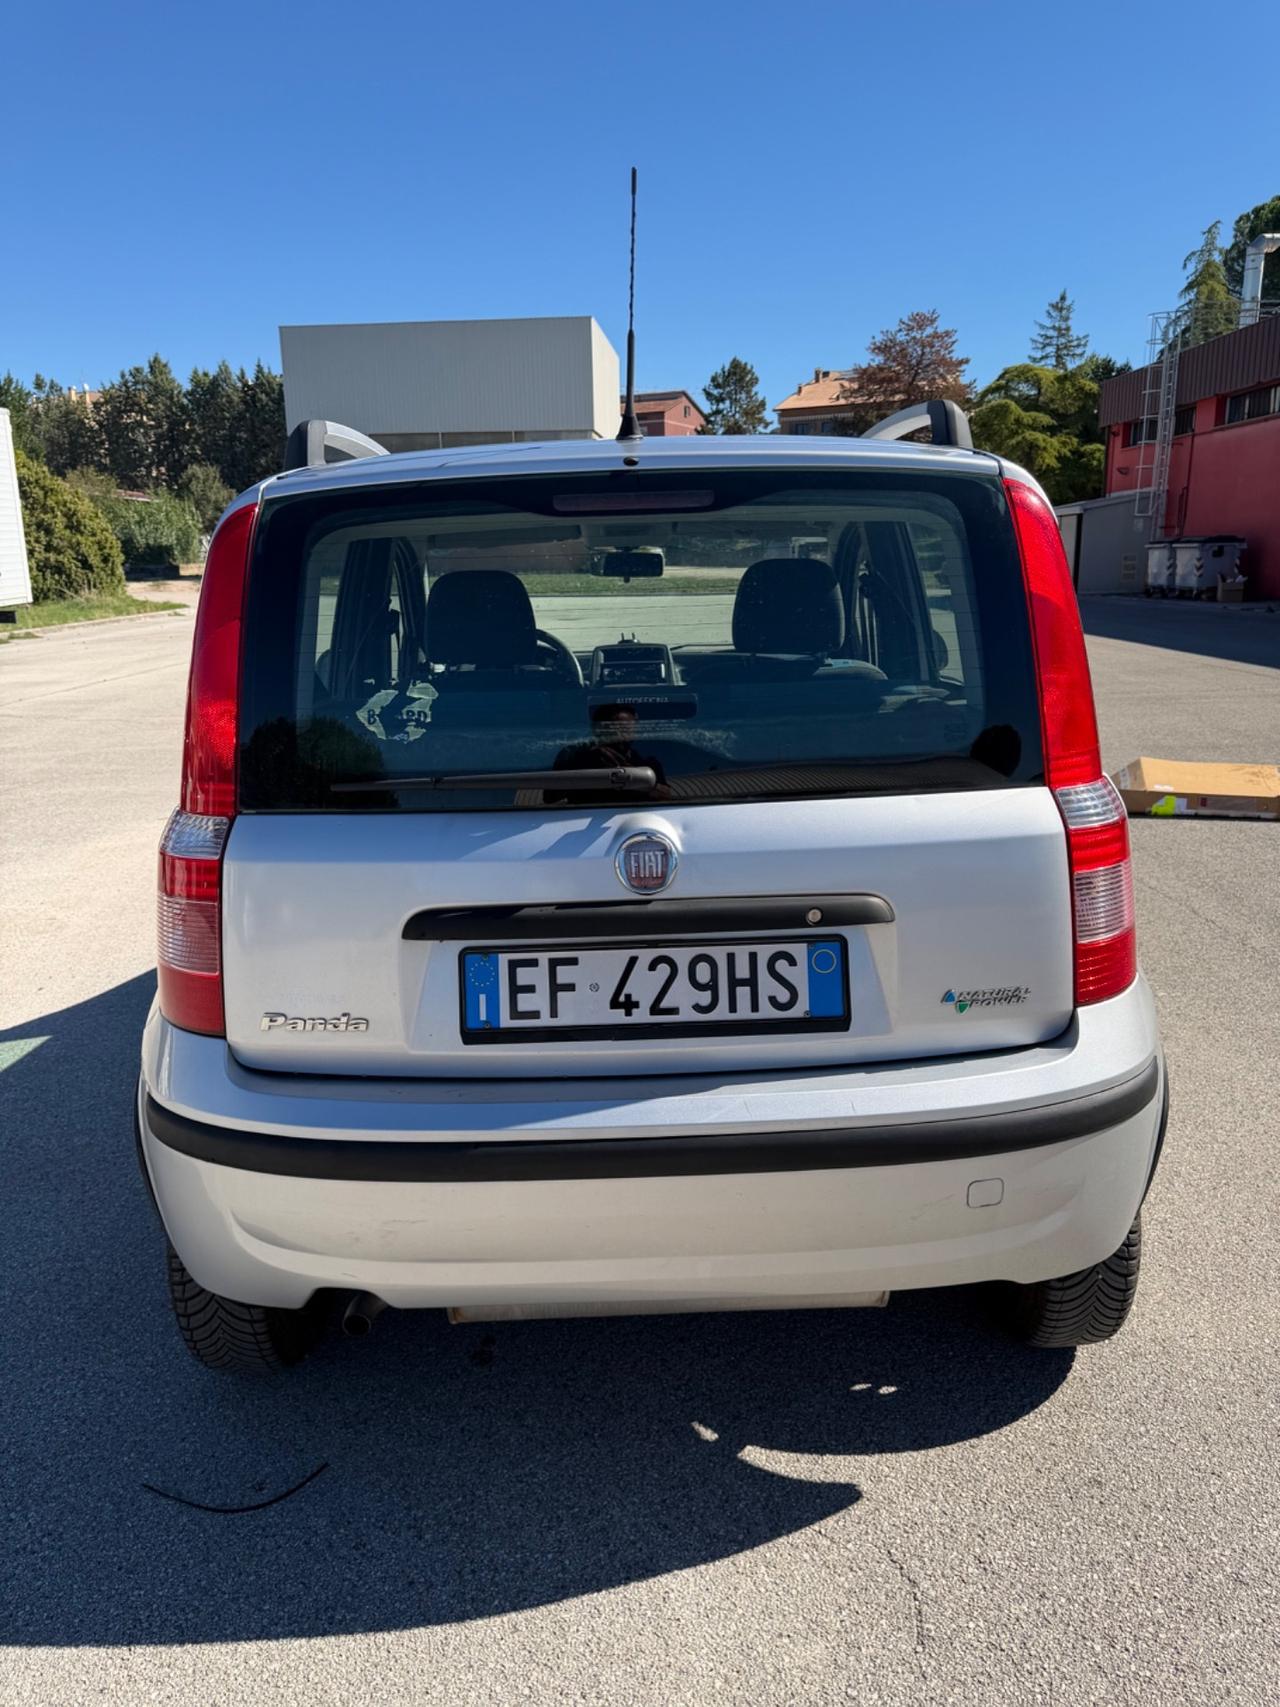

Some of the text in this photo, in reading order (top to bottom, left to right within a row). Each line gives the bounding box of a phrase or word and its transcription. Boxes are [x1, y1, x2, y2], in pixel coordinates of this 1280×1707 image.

[630, 851, 664, 878] FIAT
[507, 950, 799, 1020] EF 429HS
[479, 993, 487, 1021] I
[260, 1012, 369, 1032] Panda
